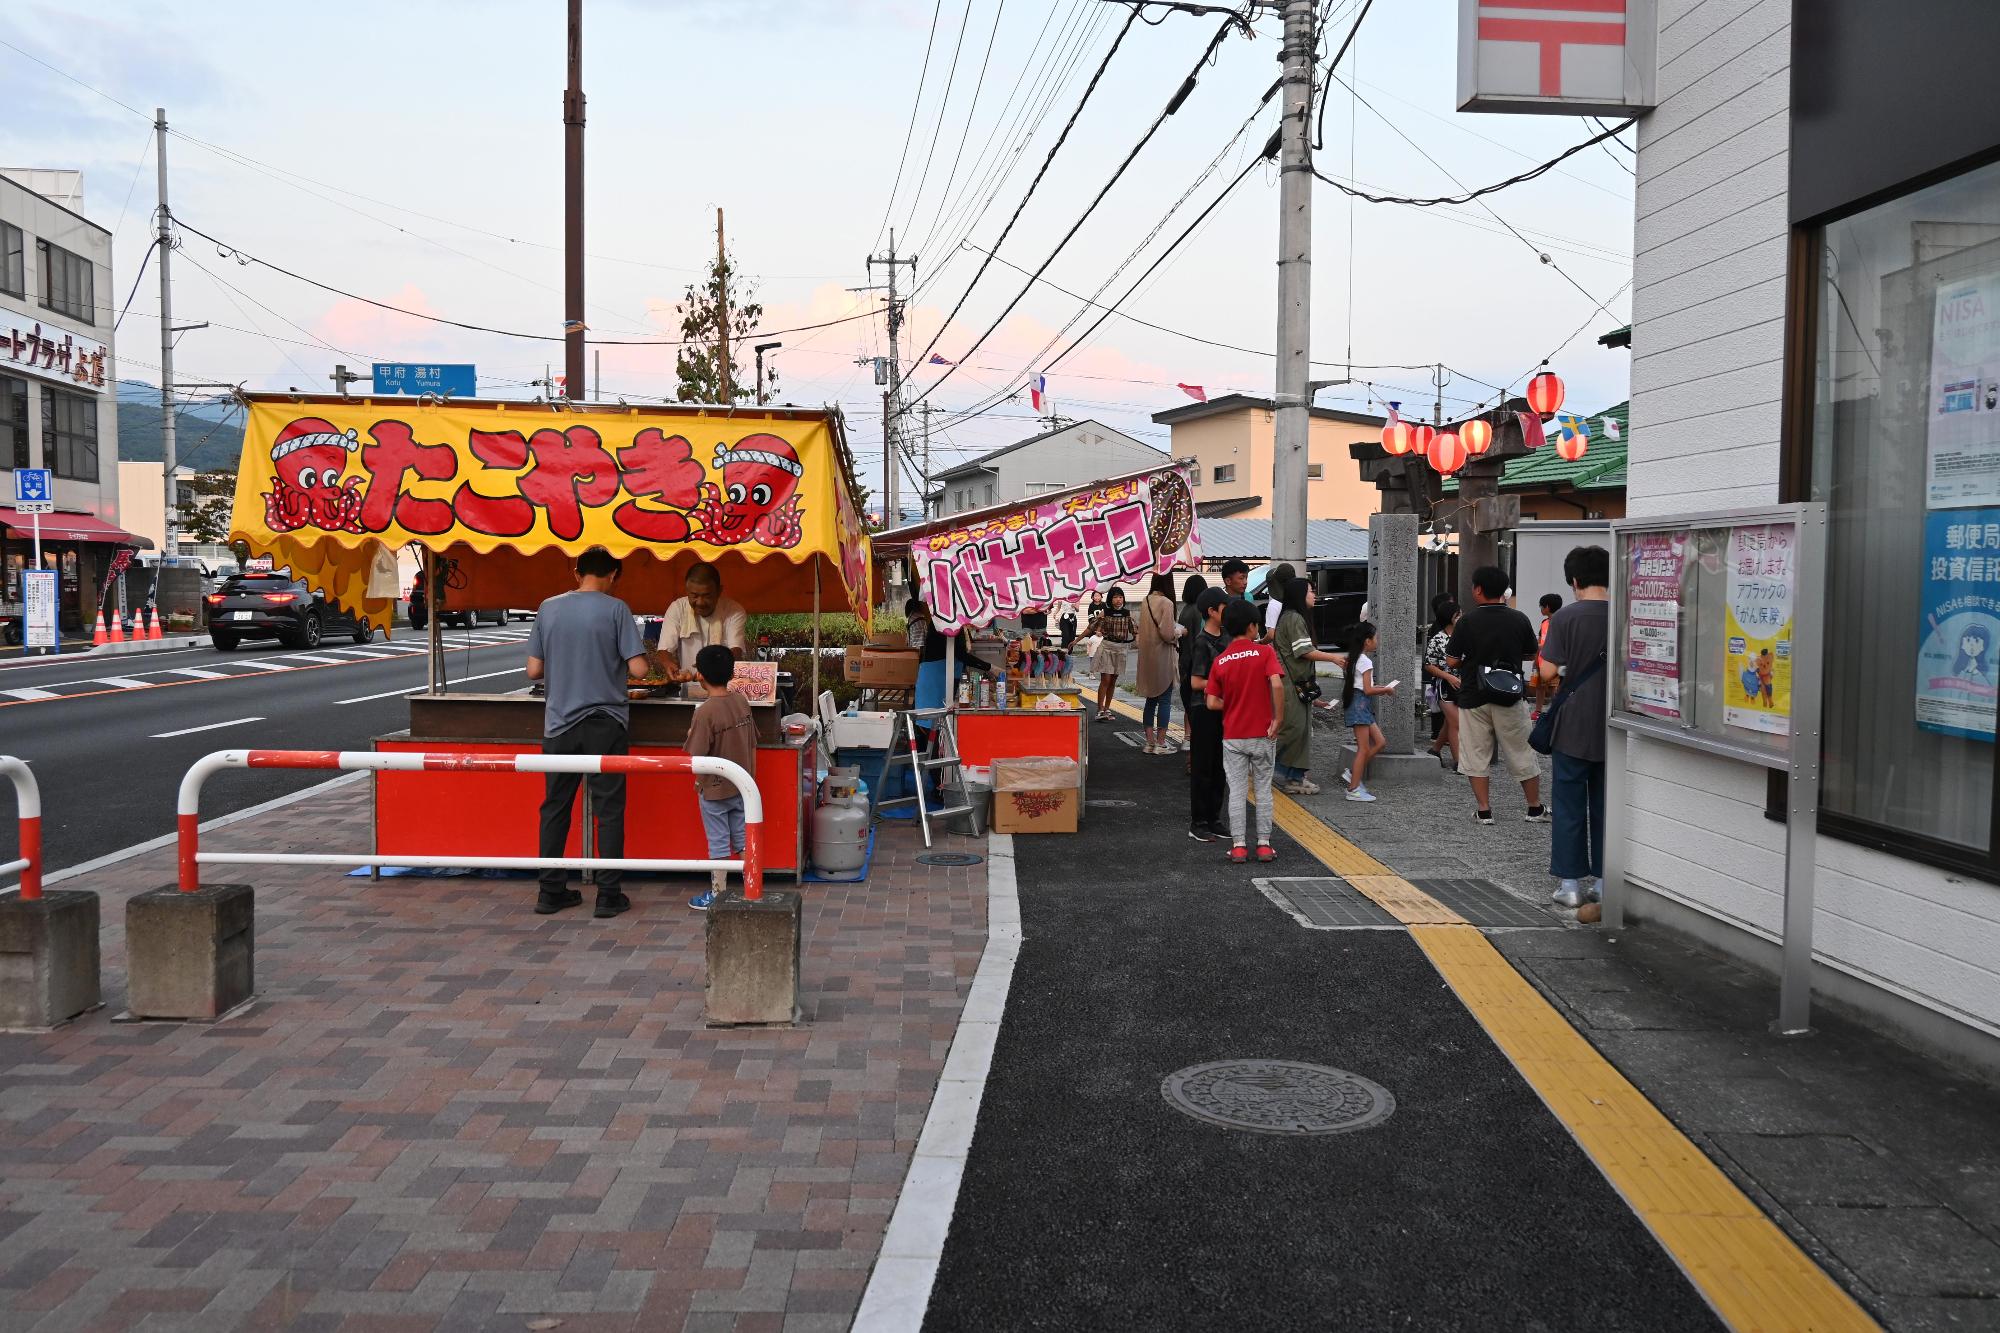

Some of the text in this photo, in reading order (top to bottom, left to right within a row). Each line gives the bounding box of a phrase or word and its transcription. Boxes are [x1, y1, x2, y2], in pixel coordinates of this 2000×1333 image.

[1940, 297, 1985, 324] NISA
[380, 366, 441, 379] 甲府 湯村
[416, 379, 441, 387] Yumura
[359, 418, 707, 542] たこやき
[18, 503, 51, 512] ここまで
[1062, 480, 1139, 516] 大人気!
[928, 509, 1039, 552] めちゃうま!
[928, 499, 1157, 624] バナナチョコ
[1737, 583, 1787, 600] アフラックの
[1218, 649, 1260, 666] DIADORA
